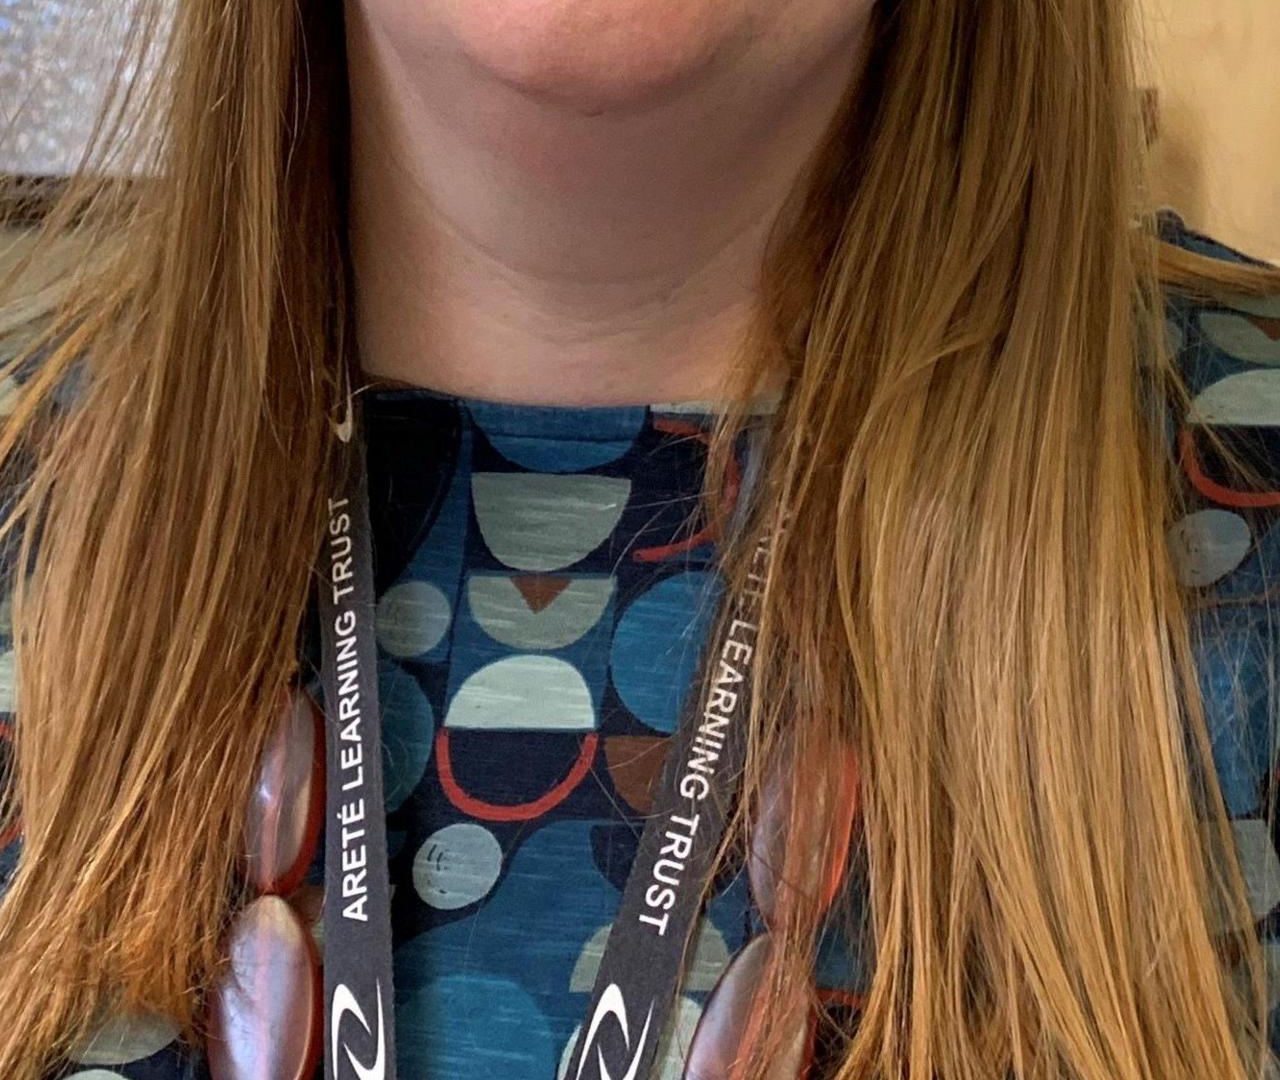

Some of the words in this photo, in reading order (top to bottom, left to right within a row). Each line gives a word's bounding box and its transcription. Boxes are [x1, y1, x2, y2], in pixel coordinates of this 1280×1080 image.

[328, 497, 355, 605] TRUST
[334, 609, 365, 792] LEARNING
[678, 618, 760, 801] LEARNING
[337, 798, 369, 922] ARETÉ
[639, 814, 702, 936] TRUST
